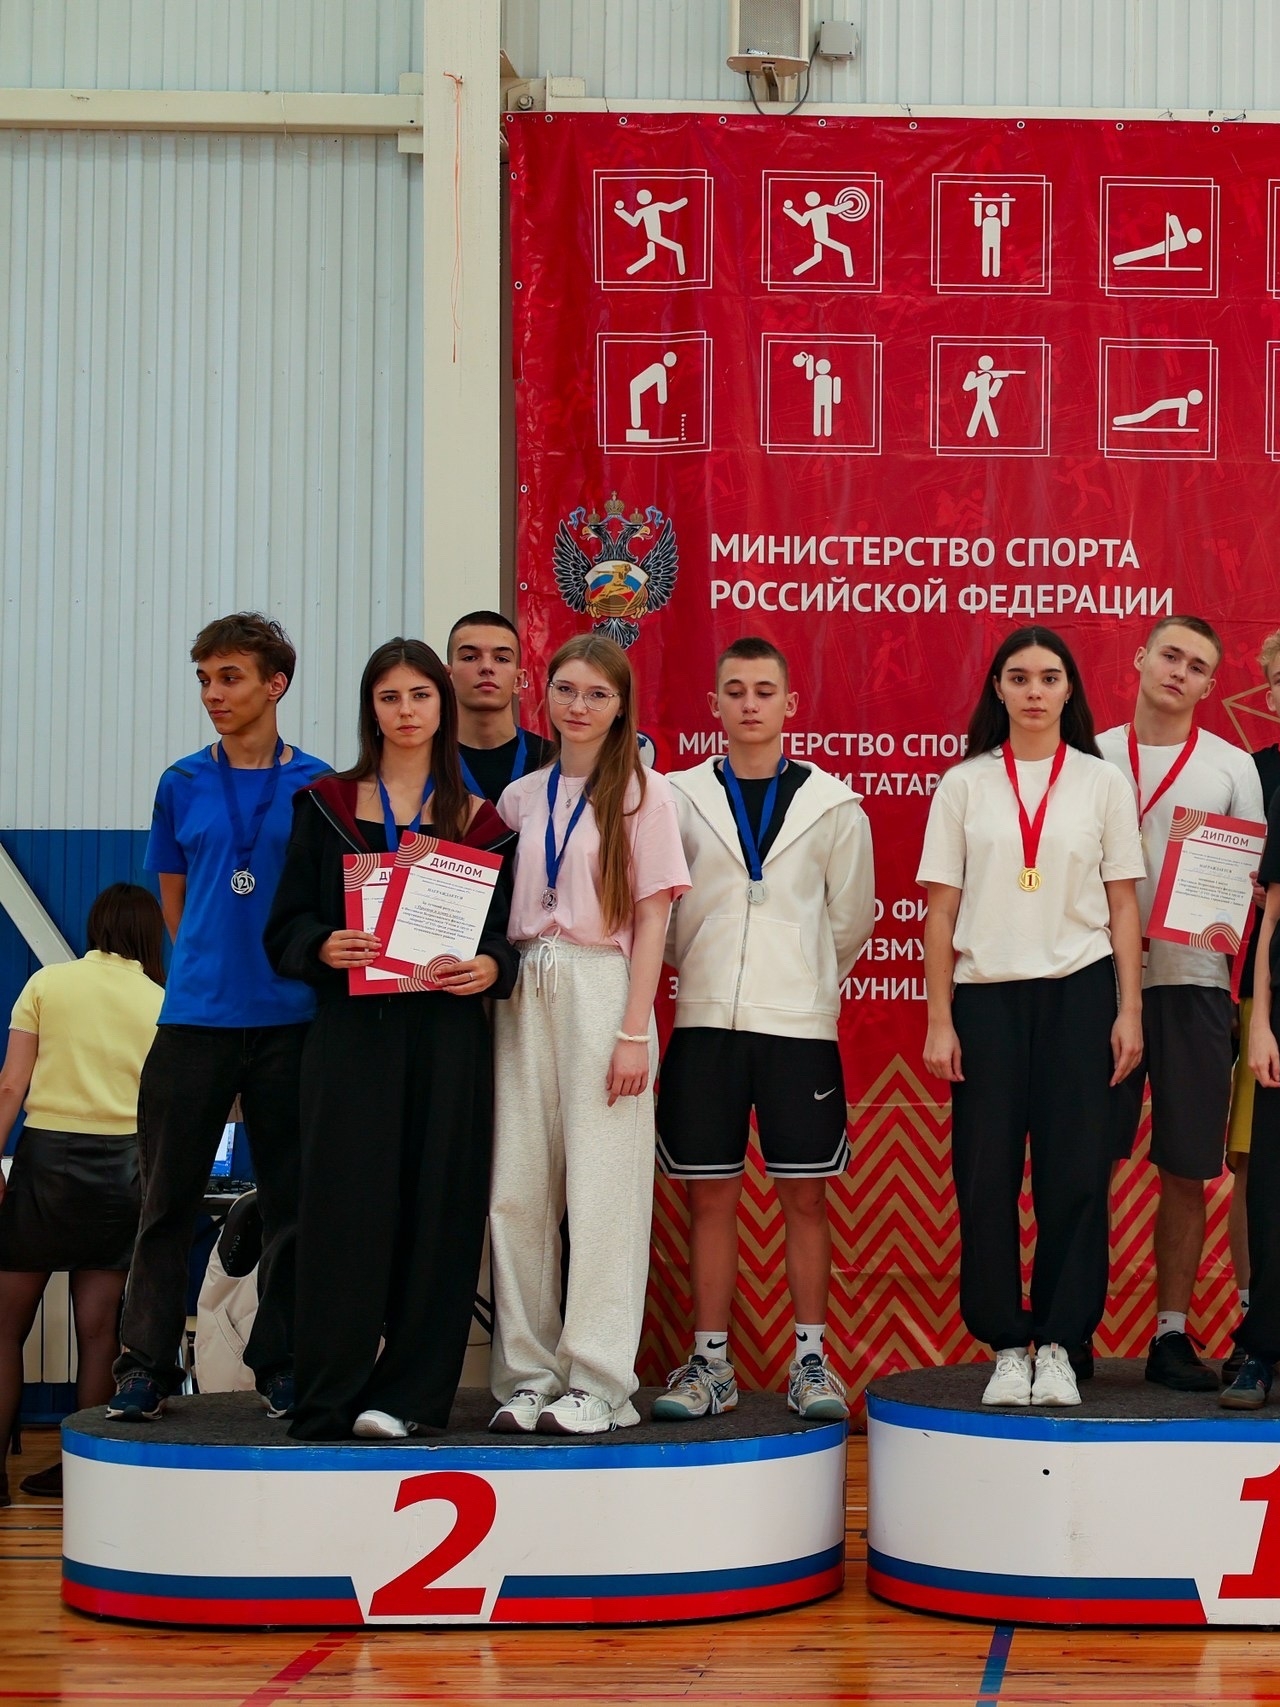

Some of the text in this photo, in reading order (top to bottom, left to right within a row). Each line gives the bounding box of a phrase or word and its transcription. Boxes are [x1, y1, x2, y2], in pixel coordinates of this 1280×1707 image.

[710, 533, 1141, 569] МИНИСТЕРСТВО СПОРТА
[710, 577, 1174, 618] РОССИЙСКОЙ ФЕДЕРАЦИИ
[678, 732, 968, 757] МИНТЕРСТВО СПОР
[1200, 829, 1250, 848] ДИПЛОМ
[429, 856, 484, 879] ДИПЛОМ
[238, 876, 248, 889] 2
[546, 894, 554, 907] 2
[367, 1471, 498, 1616] 2
